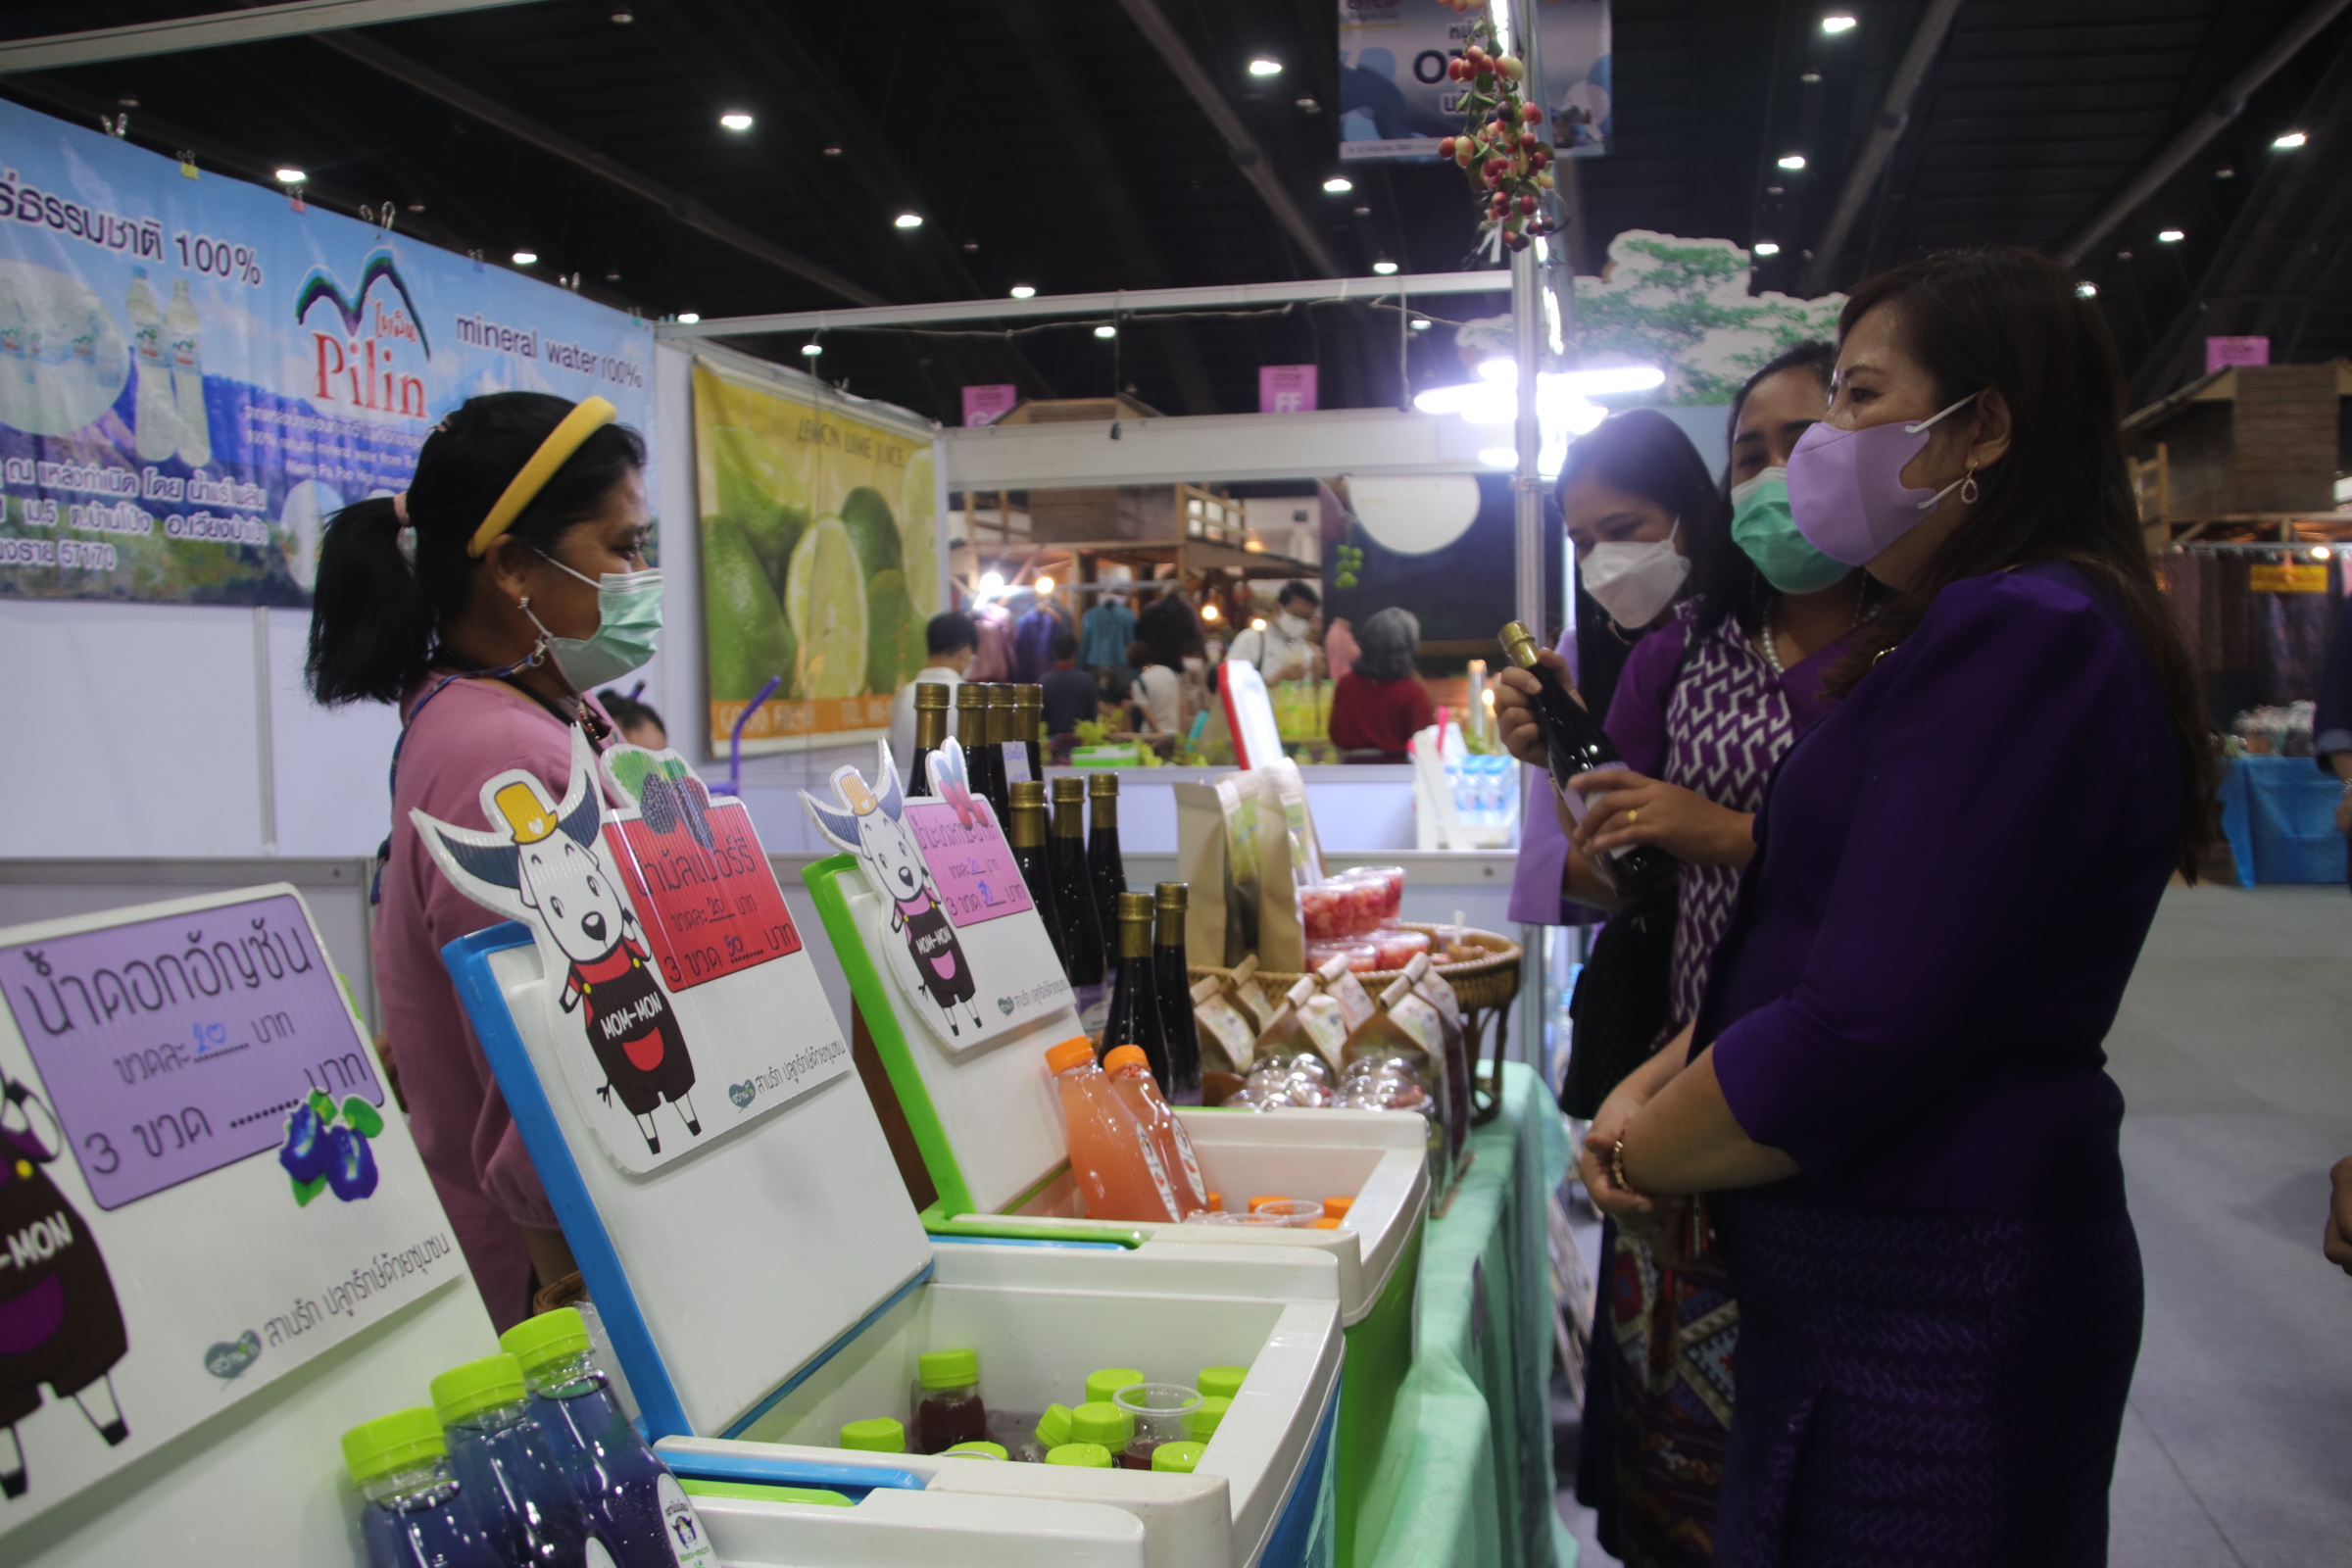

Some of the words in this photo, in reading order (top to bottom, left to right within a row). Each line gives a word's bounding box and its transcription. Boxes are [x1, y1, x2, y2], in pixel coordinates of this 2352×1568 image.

[175, 234, 262, 284] 100%
[313, 332, 429, 419] Pilin
[456, 314, 539, 359] mineral
[546, 340, 599, 374] water
[602, 355, 644, 388] 100%
[59, 541, 117, 569] 57170
[670, 909, 710, 933] ขวดละ
[707, 897, 725, 916] 20
[734, 895, 759, 915] บาท
[946, 897, 958, 915] 3
[1004, 884, 1027, 903] บาท
[663, 956, 682, 983] 3
[684, 947, 724, 977] ขวด
[723, 934, 745, 957] 50
[763, 923, 798, 951] บาท
[915, 925, 953, 956] MOM-MON
[23, 917, 314, 1036] น้ำดอกอัญชัน
[600, 991, 663, 1041] MOM-MON
[113, 1042, 191, 1085] ขวดละ
[250, 1011, 296, 1044] บาท
[83, 1132, 121, 1175] 3
[132, 1106, 214, 1158] ขวด
[303, 1053, 368, 1097] บาท
[264, 1298, 323, 1348] สานรัก
